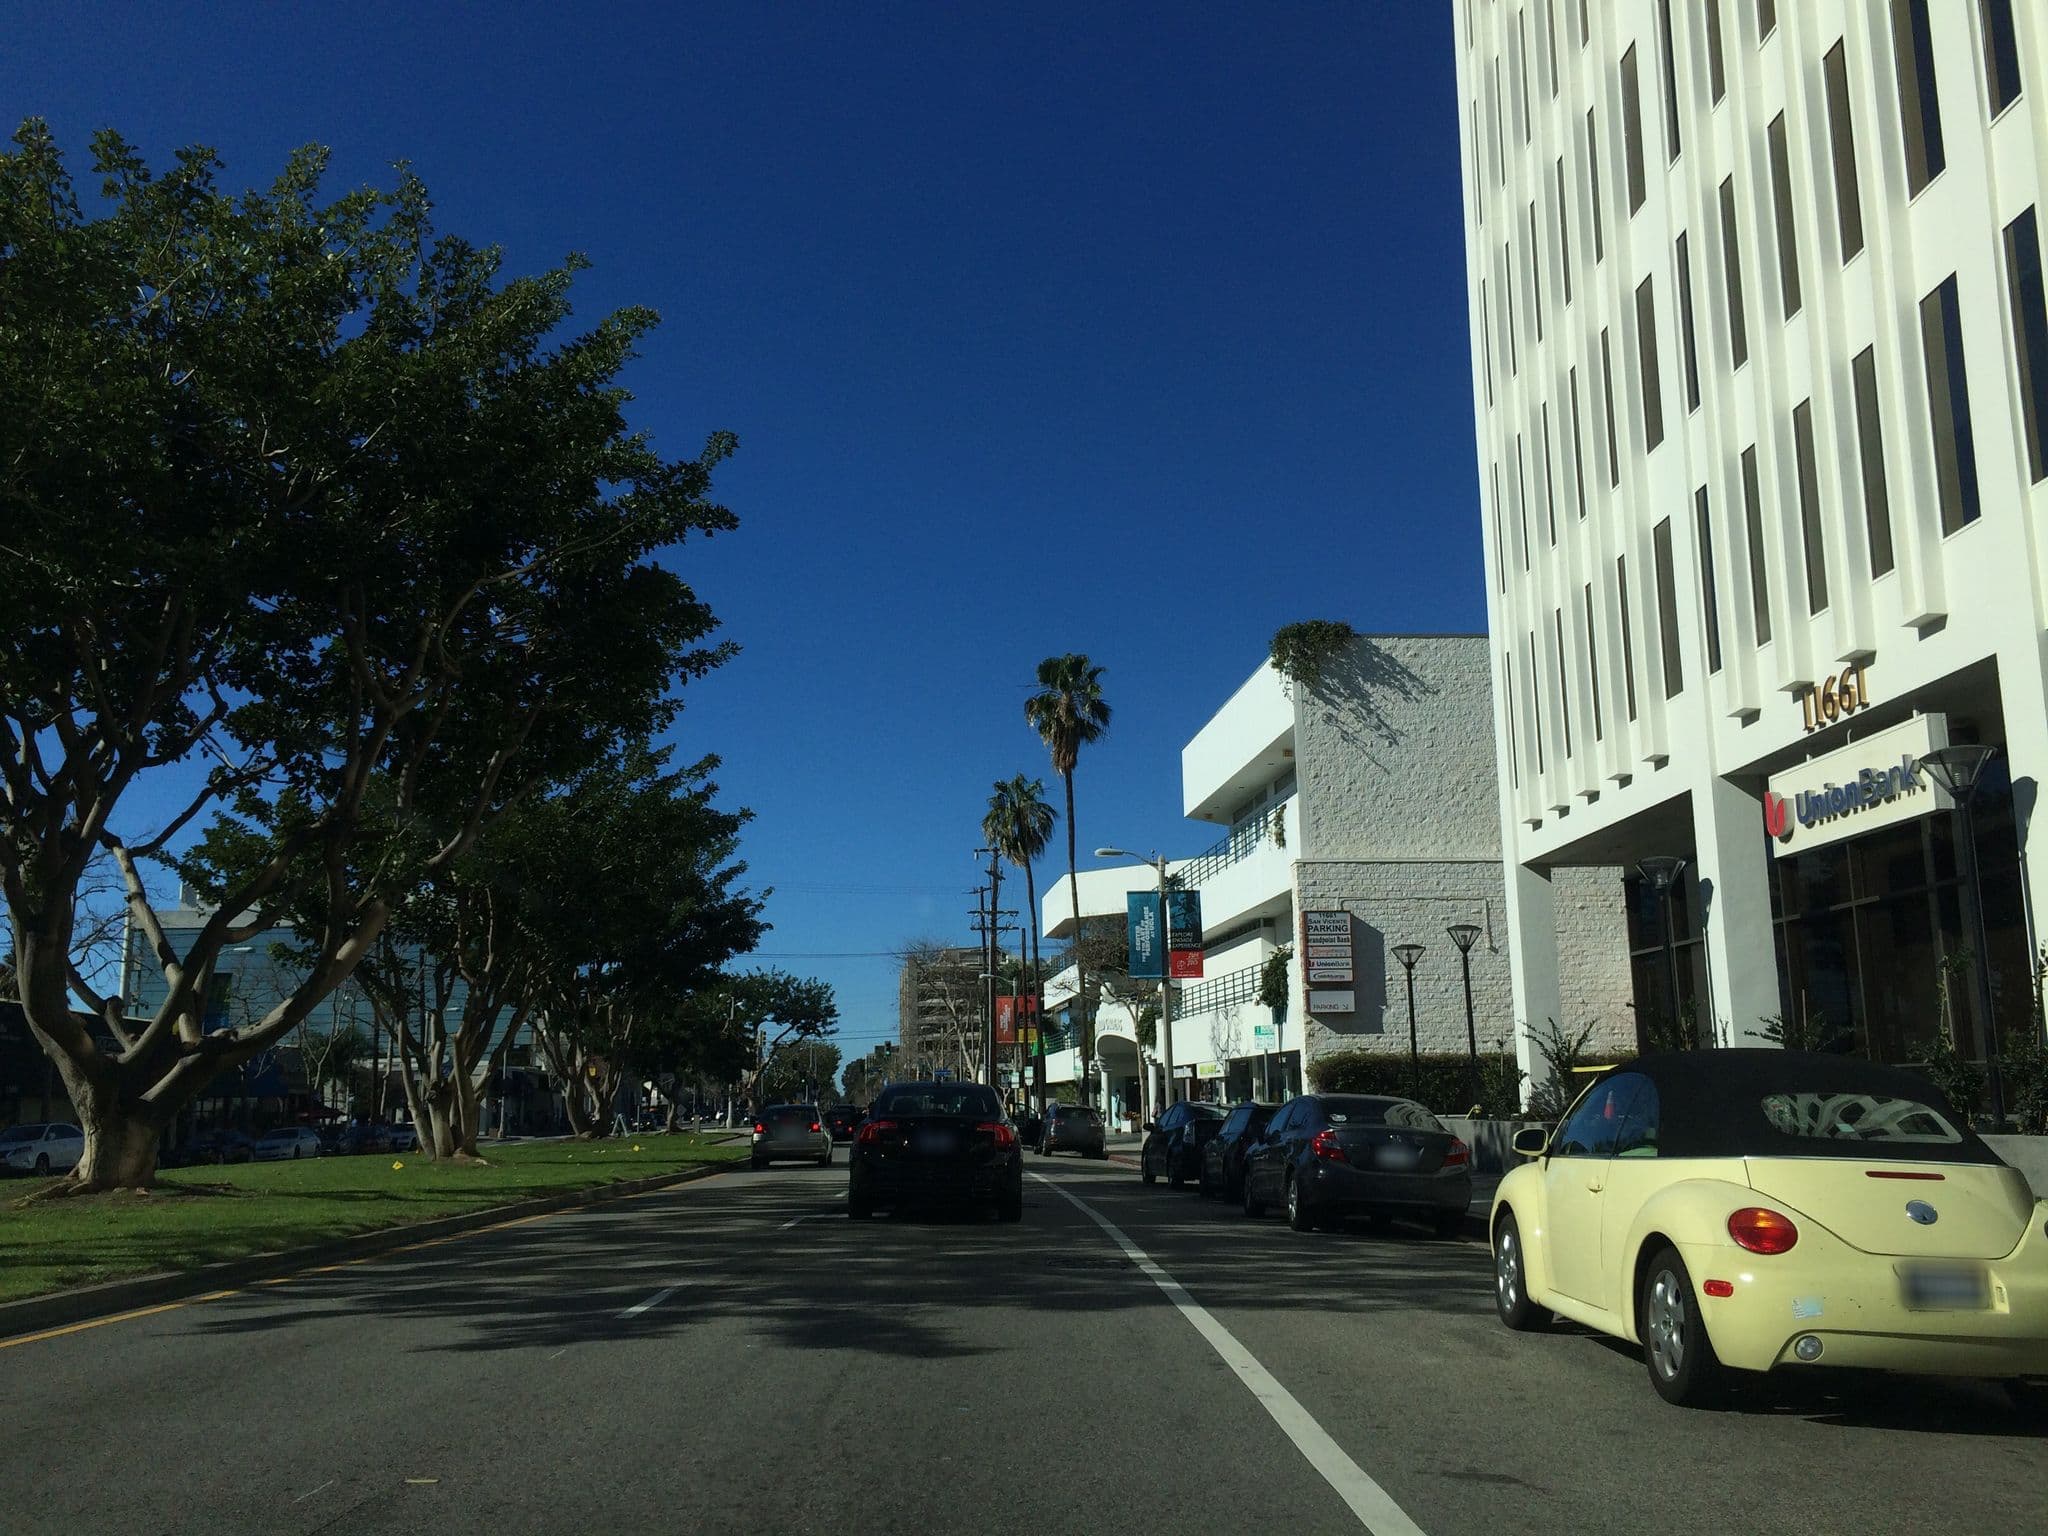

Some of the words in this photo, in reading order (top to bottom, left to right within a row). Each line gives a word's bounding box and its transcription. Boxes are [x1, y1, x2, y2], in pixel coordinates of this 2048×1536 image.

[1802, 666, 1870, 734] 11661
[1795, 754, 1927, 826] UnionBank
[1307, 924, 1349, 932] PARKING
